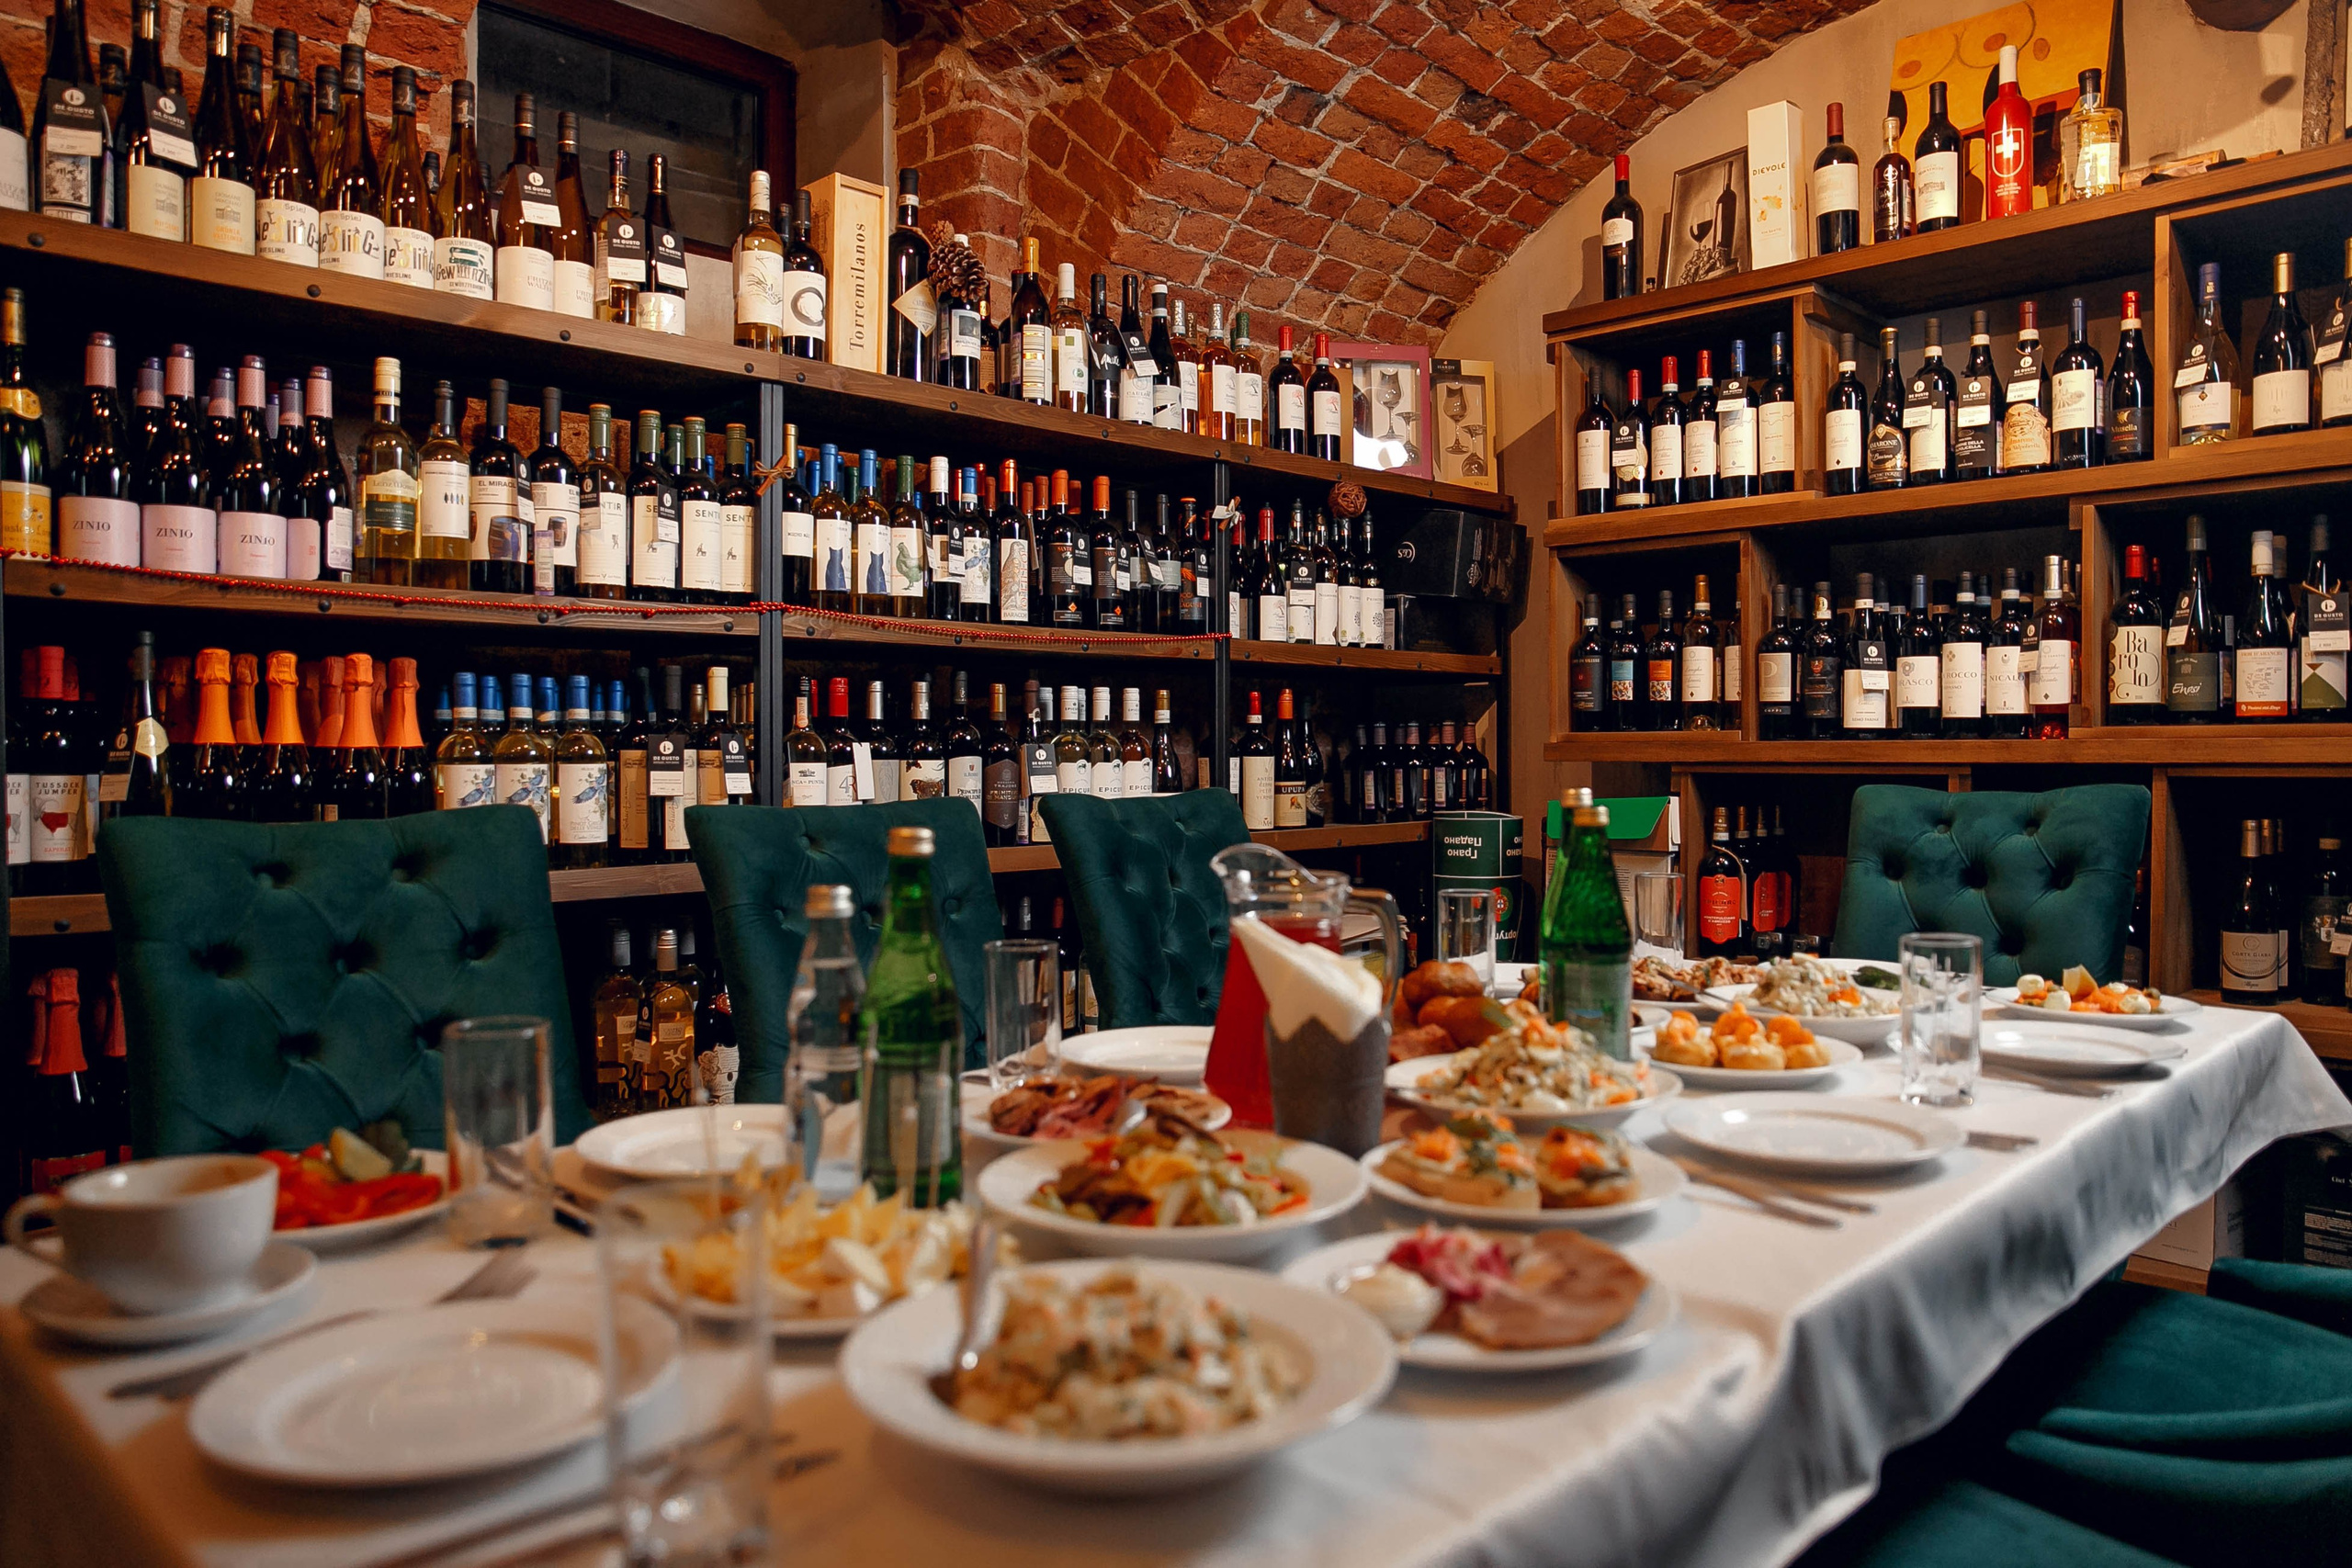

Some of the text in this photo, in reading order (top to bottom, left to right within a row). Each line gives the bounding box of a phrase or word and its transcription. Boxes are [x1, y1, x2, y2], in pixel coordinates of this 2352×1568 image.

[1752, 162, 1786, 176] DIEVOLE
[532, 186, 551, 194] GUSTO
[849, 222, 866, 351] Torremilanos
[2111, 423, 2138, 433] Musella
[488, 480, 516, 489] MIRACL
[601, 502, 622, 511] NTIR
[73, 520, 111, 532] ZINIO
[156, 527, 194, 539] ZINIO
[240, 535, 276, 547] ZINIO
[1443, 836, 1482, 847] Падано
[1447, 849, 1478, 859] Грано
